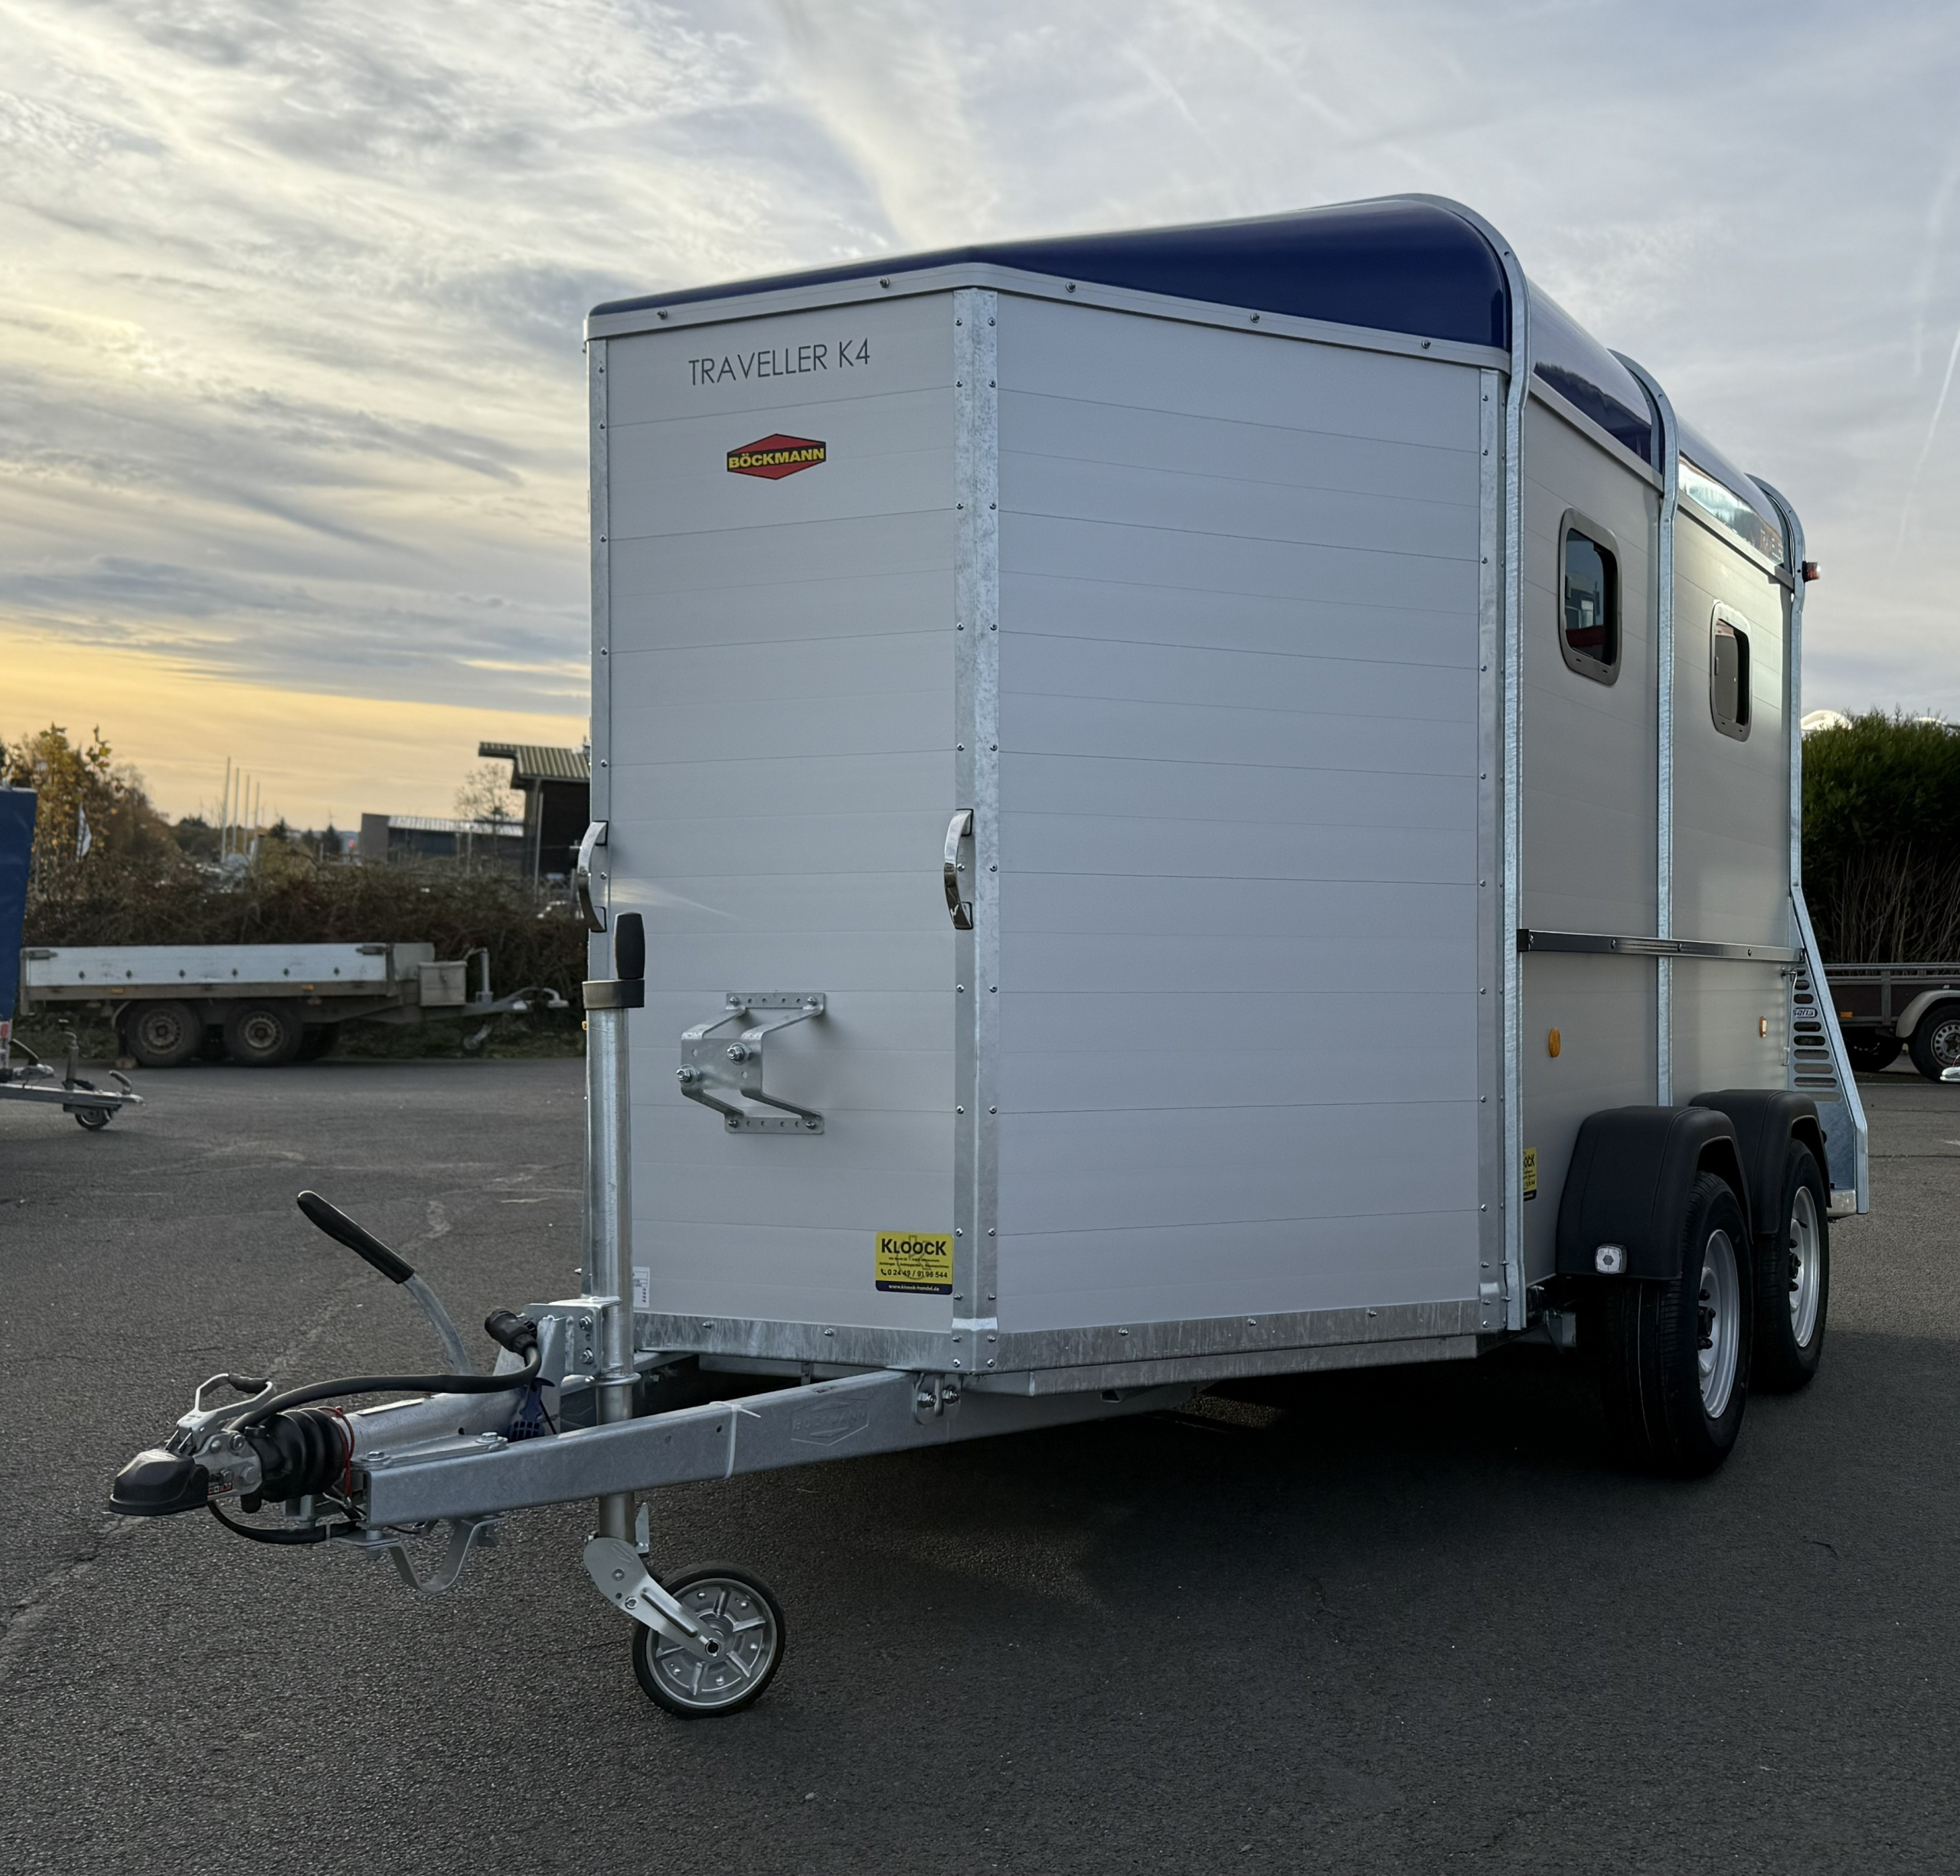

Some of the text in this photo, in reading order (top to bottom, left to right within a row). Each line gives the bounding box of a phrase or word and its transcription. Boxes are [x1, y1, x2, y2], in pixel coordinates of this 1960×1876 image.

[689, 338, 871, 385] TRAVELLER K4
[728, 448, 825, 469] BÖCKMANN
[881, 1238, 946, 1256] KLOOCK
